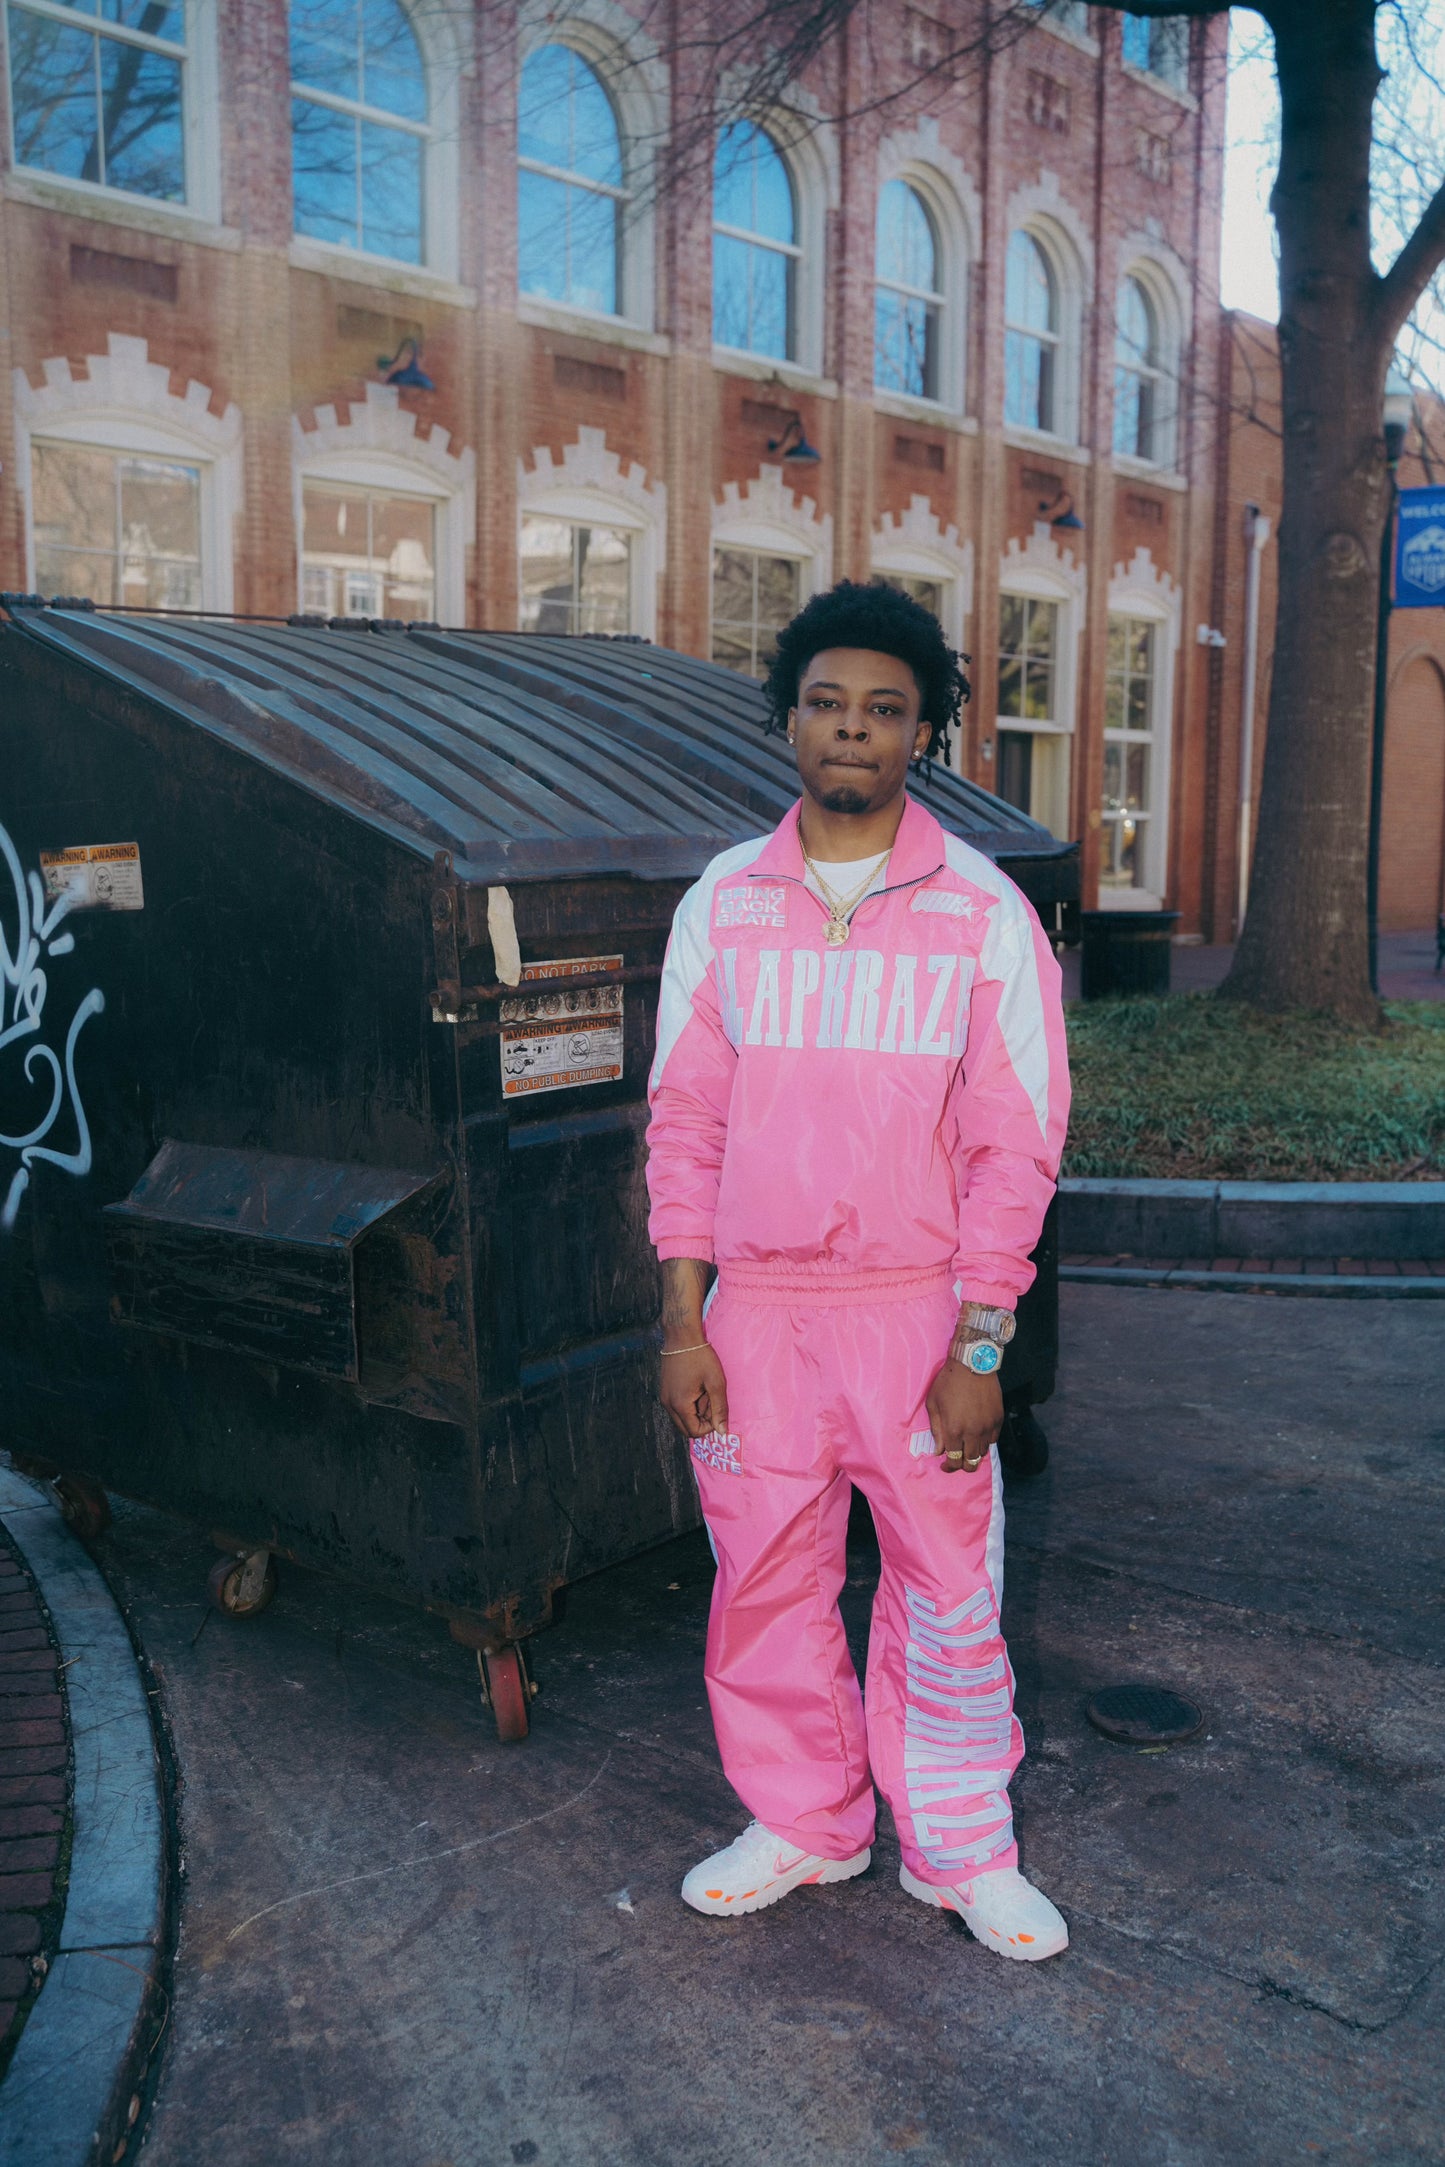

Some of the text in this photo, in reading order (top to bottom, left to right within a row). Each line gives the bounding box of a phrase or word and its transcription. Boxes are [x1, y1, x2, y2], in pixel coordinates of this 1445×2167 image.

[97, 847, 136, 860] WARNING
[718, 886, 785, 901] BRING
[720, 899, 780, 913] BACK
[716, 912, 785, 928] SKATE
[539, 966, 567, 979] NOT
[571, 962, 608, 976] PARK
[714, 947, 976, 1058] LAPKRAZE
[512, 1025, 562, 1038] WARNING
[571, 1017, 619, 1031] WARNING
[514, 1079, 530, 1091] NO
[532, 1073, 567, 1087] PUBLIC
[569, 1066, 611, 1082] DUMPING
[693, 1443, 742, 1475] SKATE
[904, 1584, 1014, 1870] SLAPKRAZE
